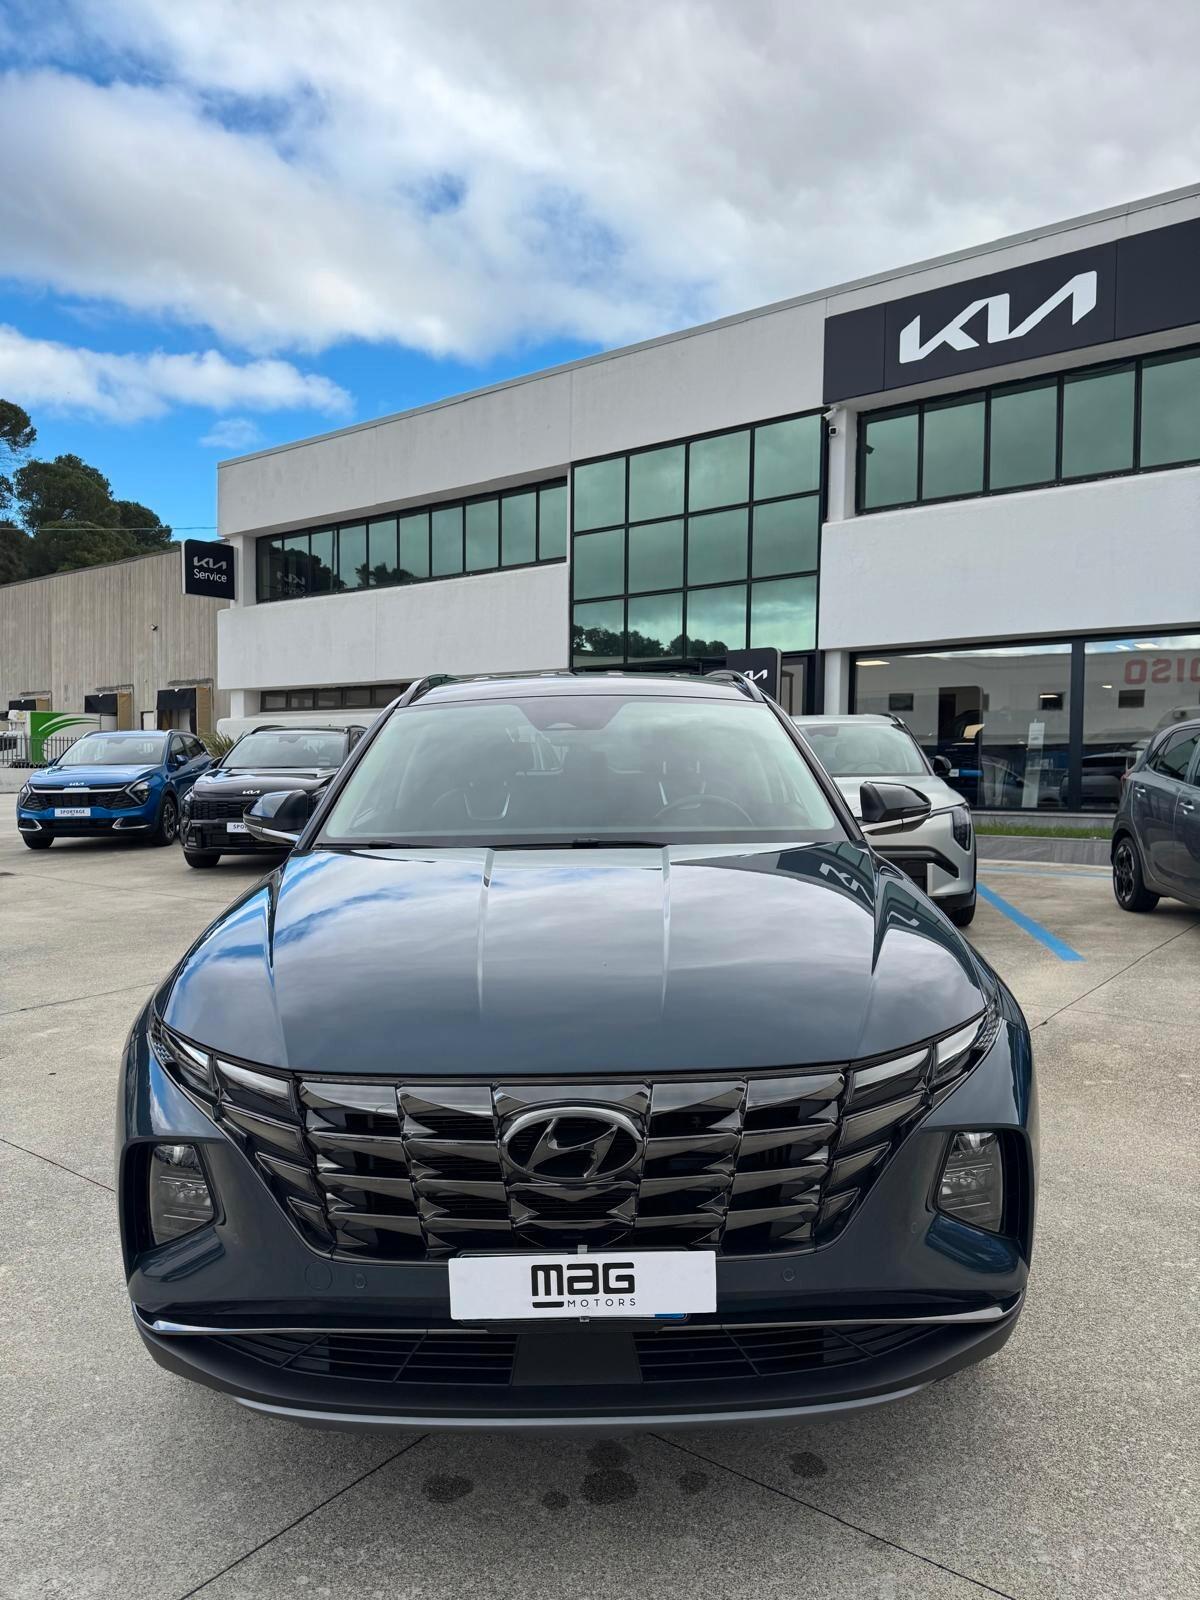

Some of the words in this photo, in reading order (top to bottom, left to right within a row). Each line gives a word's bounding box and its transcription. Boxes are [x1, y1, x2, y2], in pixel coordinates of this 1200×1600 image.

[899, 270, 1098, 364] KIA
[193, 555, 227, 570] KIA
[193, 568, 227, 583] Service
[743, 669, 768, 680] IA
[567, 1298, 636, 1308] MOTORS
